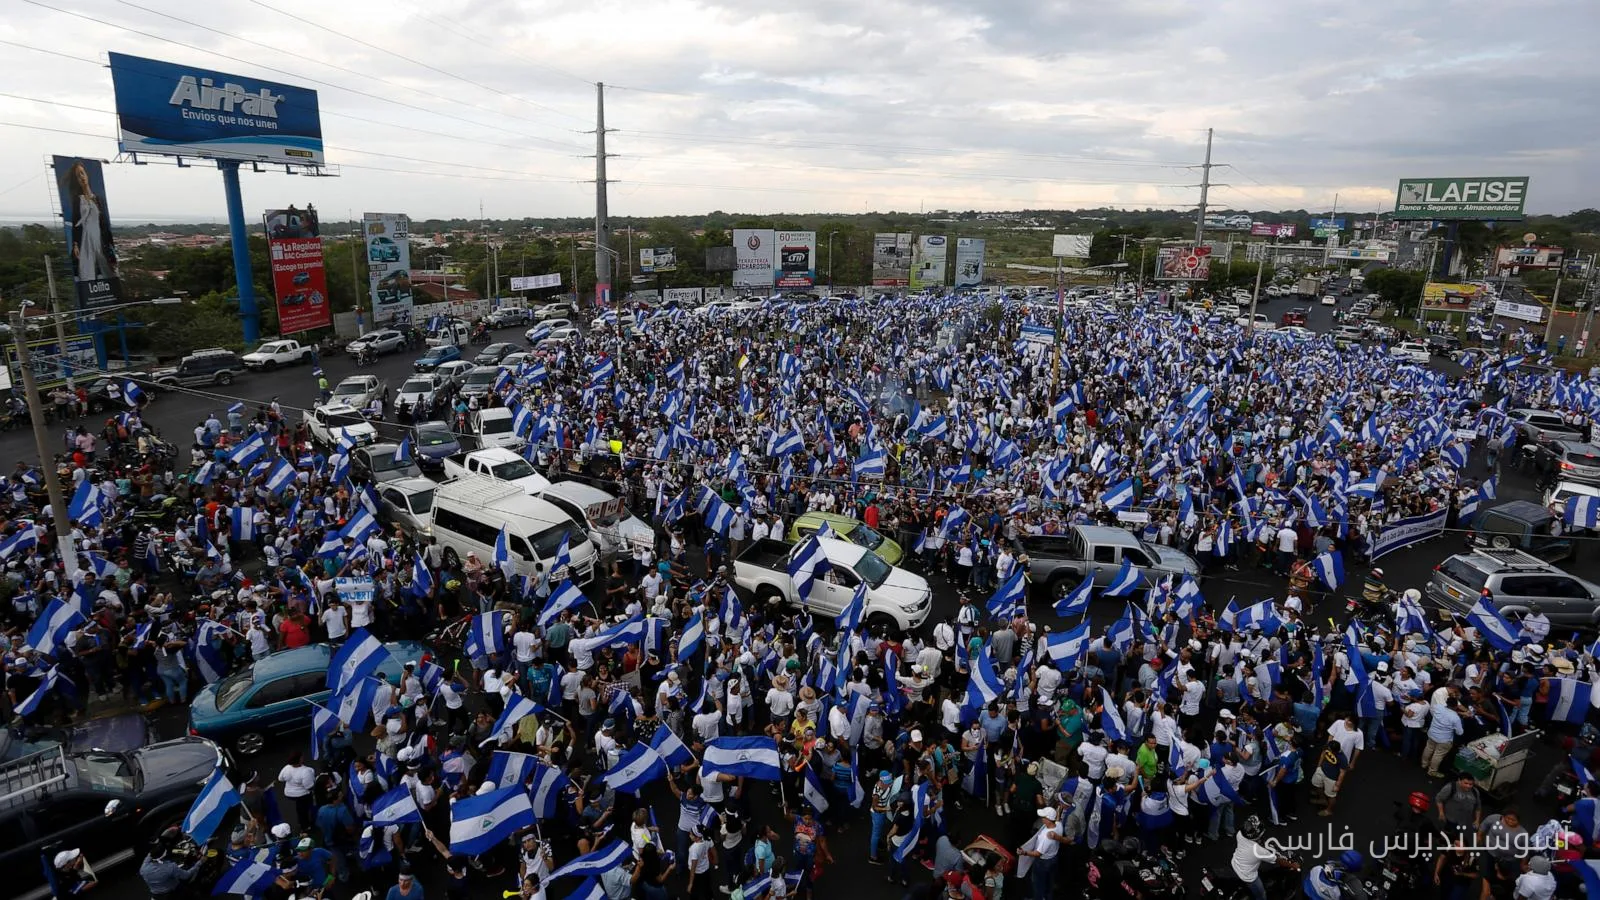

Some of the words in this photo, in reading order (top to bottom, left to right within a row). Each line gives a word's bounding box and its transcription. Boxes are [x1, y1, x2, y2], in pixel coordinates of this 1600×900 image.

[169, 75, 279, 118] AirPak
[217, 114, 236, 125] que
[238, 117, 254, 127] nos
[255, 120, 278, 130] unen
[1425, 182, 1524, 202] LAFISE
[1427, 204, 1458, 212] Seguros
[1463, 203, 1520, 212] Almacenadora
[780, 232, 791, 242] 60
[283, 243, 292, 252] La
[292, 241, 321, 252] Regalona
[89, 281, 110, 293] Lolita
